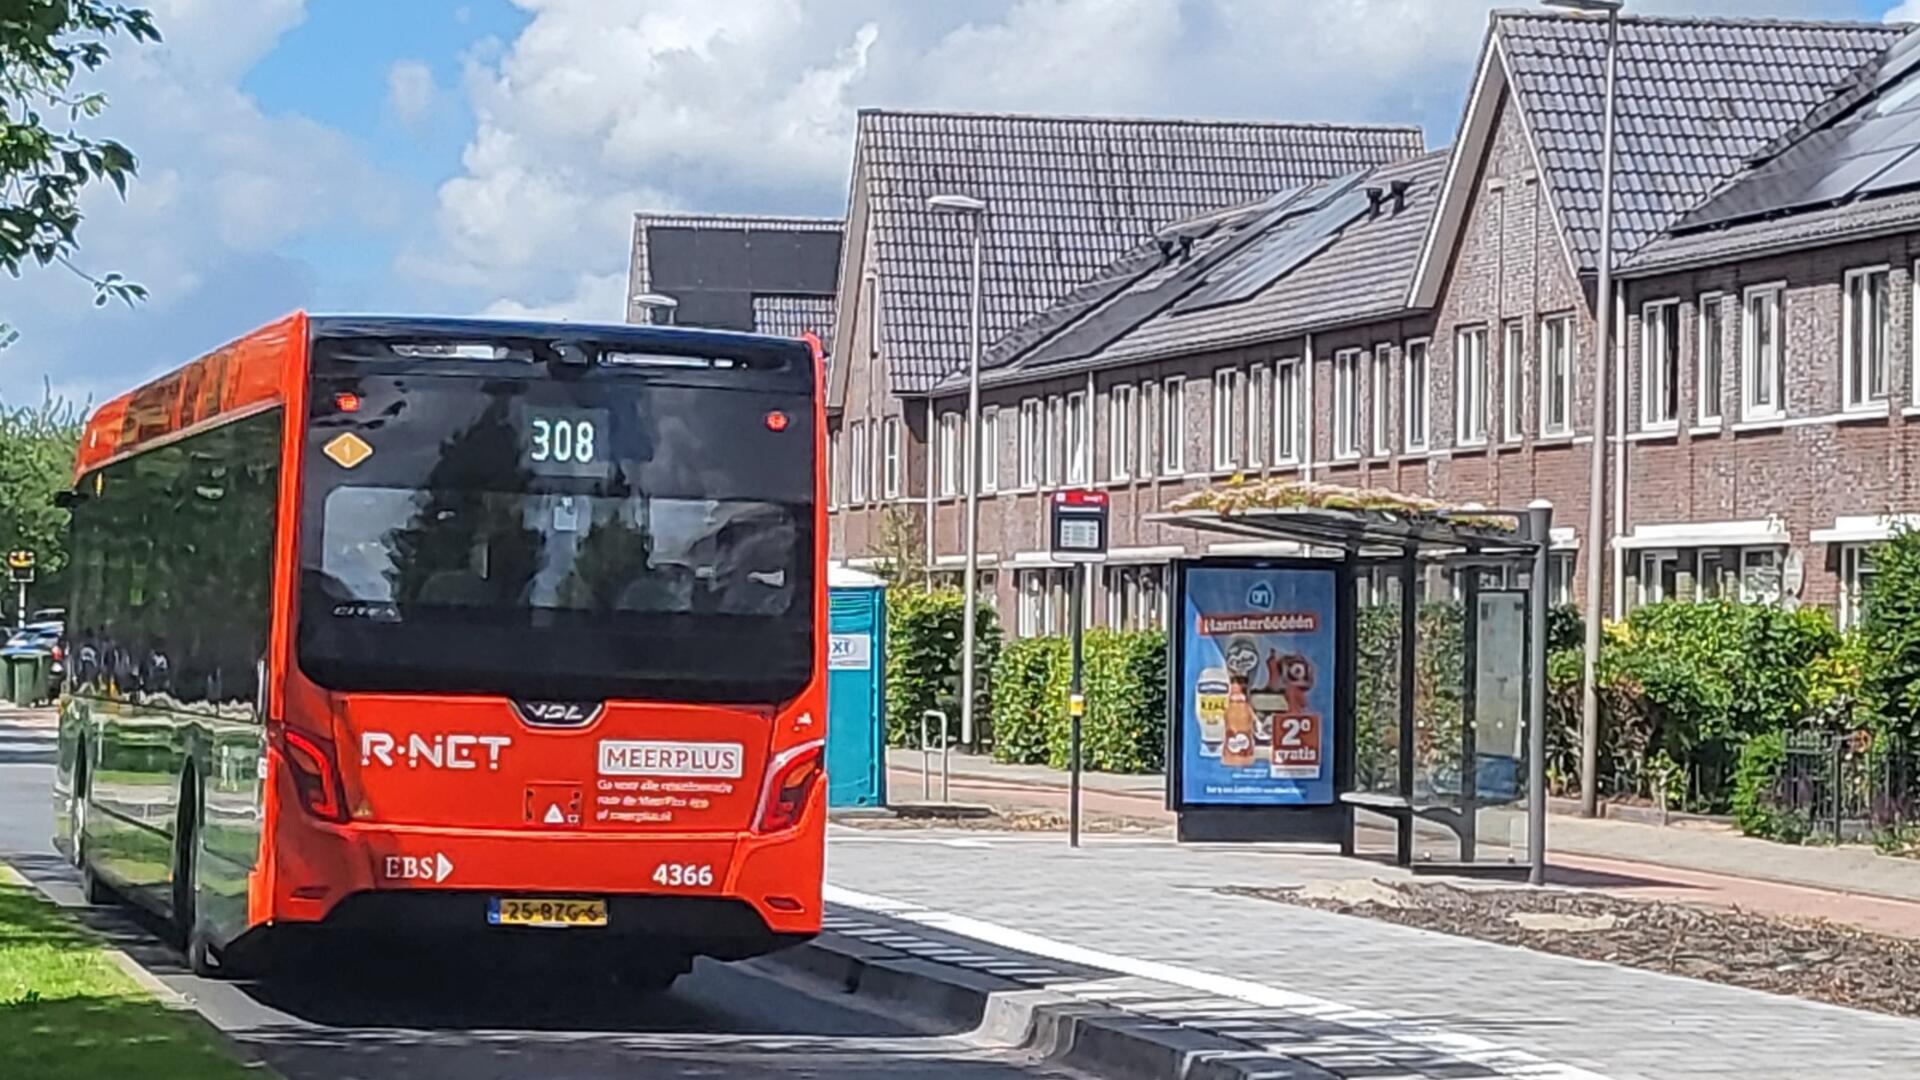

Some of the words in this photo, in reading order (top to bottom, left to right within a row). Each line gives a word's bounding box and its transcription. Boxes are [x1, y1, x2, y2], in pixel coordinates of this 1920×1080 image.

[531, 420, 594, 462] 308
[606, 748, 735, 770] MEERPLUS
[1274, 746, 1317, 764] gratis
[385, 856, 433, 880] EBS
[652, 863, 713, 886] 4366
